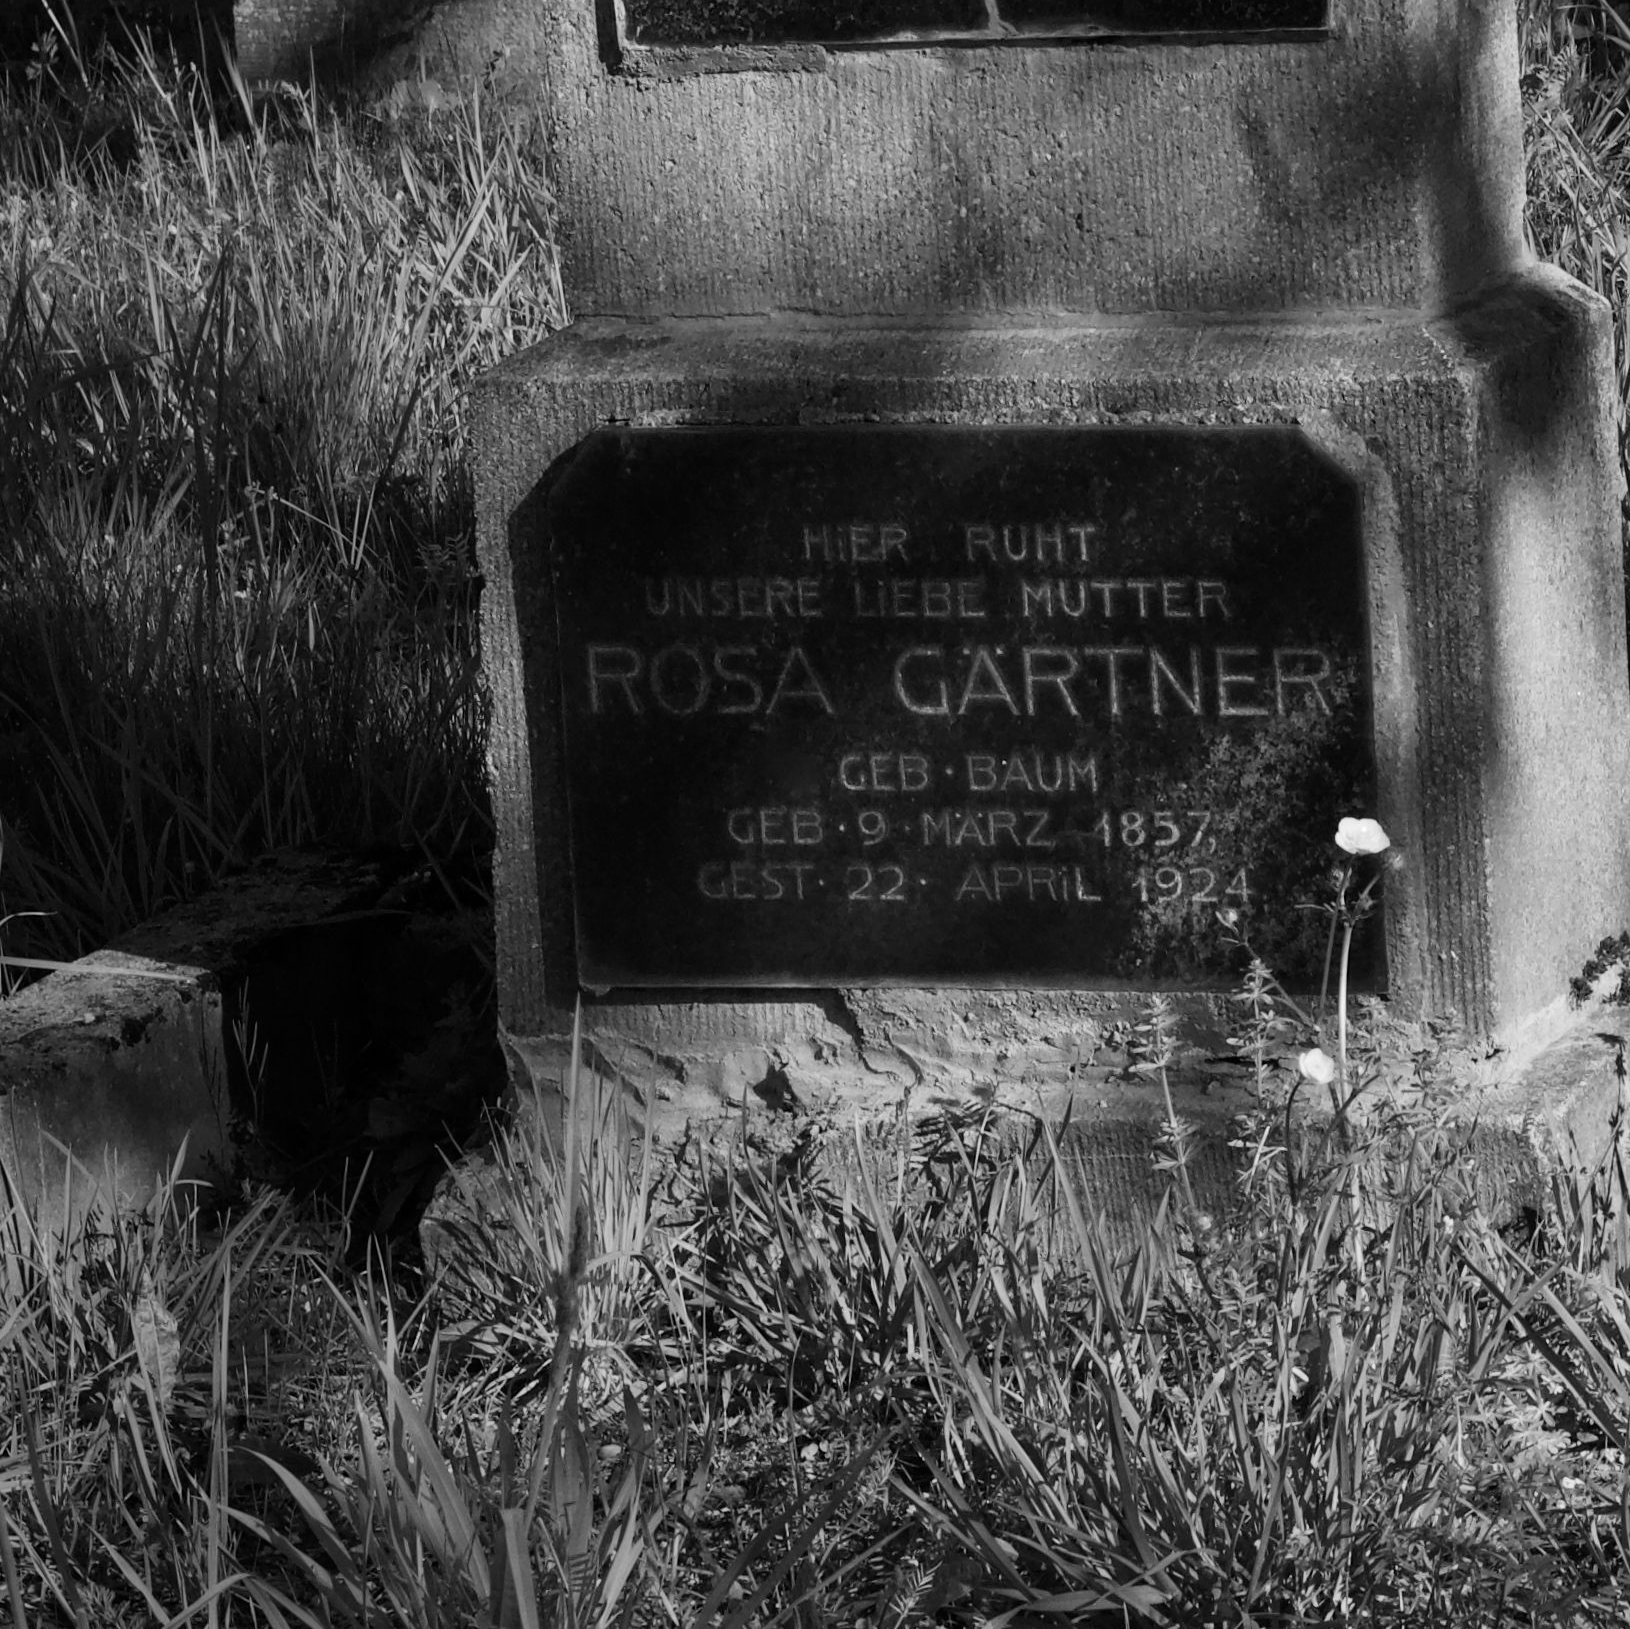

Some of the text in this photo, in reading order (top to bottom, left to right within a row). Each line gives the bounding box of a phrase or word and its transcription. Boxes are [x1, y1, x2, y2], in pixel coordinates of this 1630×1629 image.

[966, 524, 1098, 564] RUHT
[643, 576, 823, 620] UNSERE
[1019, 578, 1234, 620] MUTTER
[584, 640, 1338, 718] ROSA GÄRTNER
[965, 751, 1101, 794] BAUM
[919, 806, 1054, 849] MÄRZ
[1131, 866, 1256, 904] 1924
